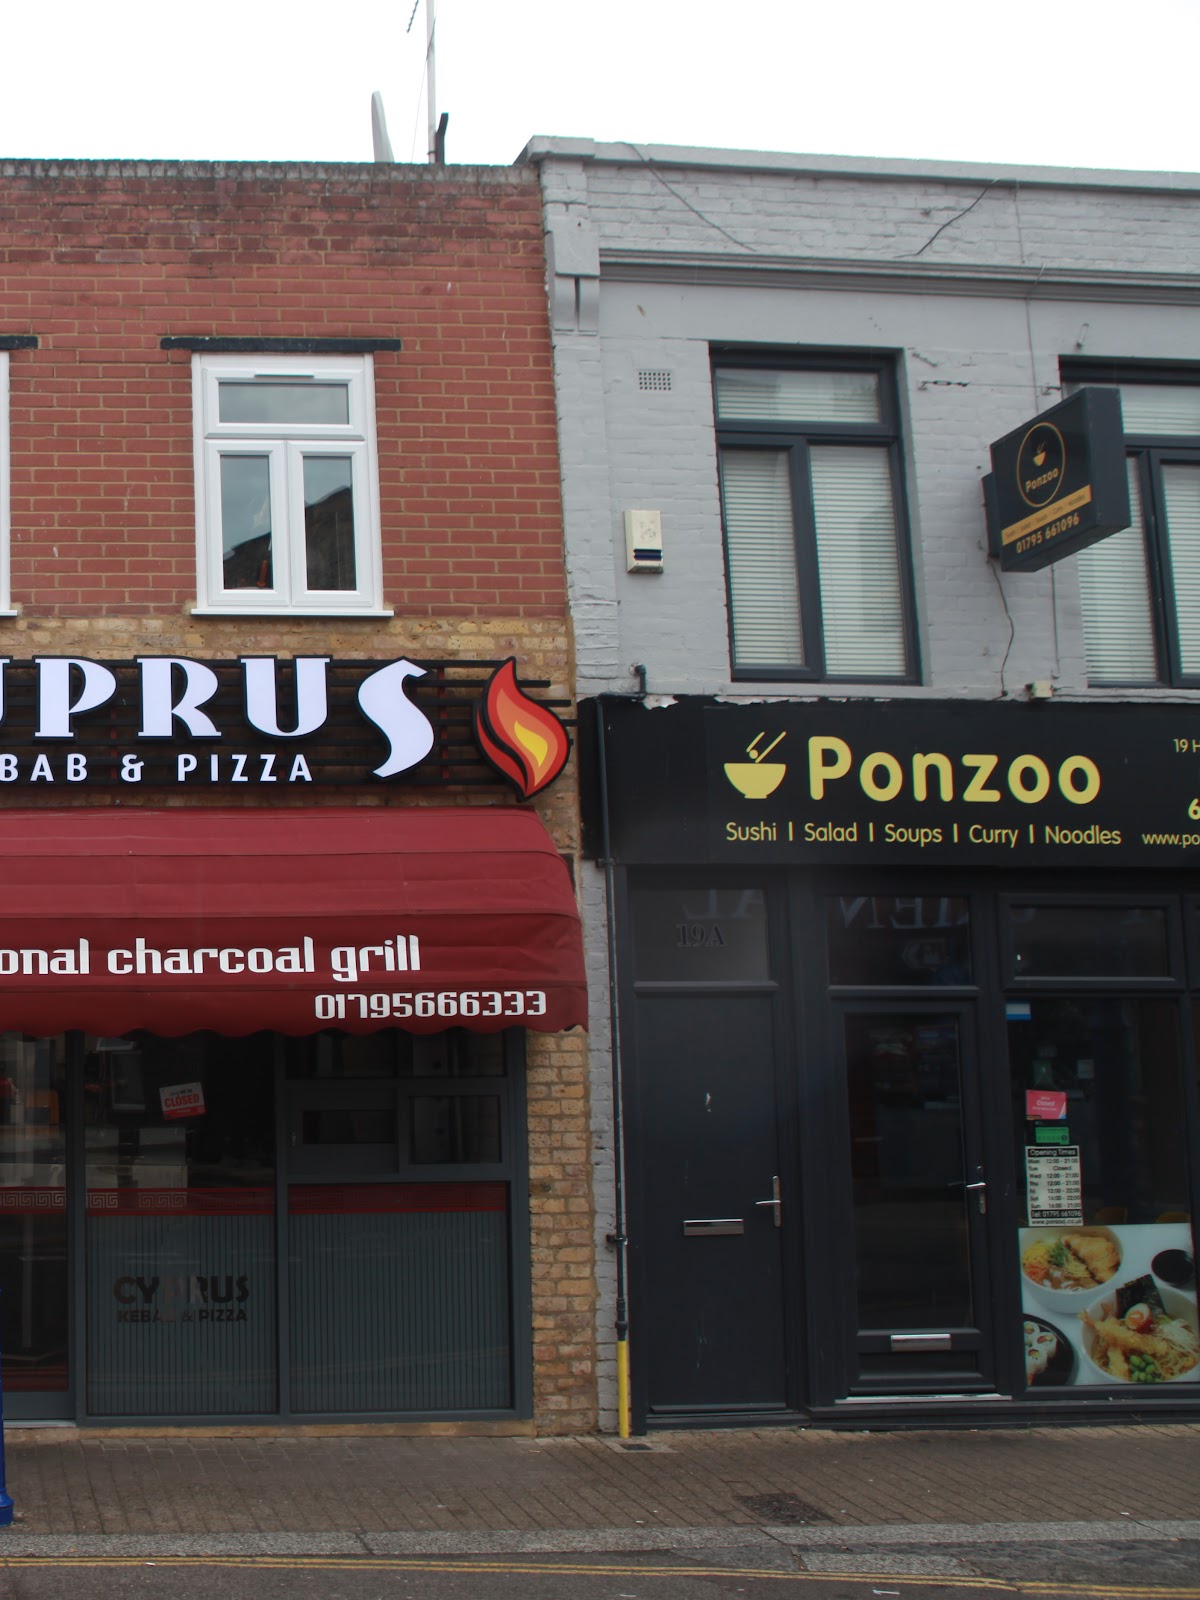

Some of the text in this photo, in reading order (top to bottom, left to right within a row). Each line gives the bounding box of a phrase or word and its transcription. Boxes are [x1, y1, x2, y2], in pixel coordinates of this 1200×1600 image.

[1025, 467, 1059, 493] Ponzoo
[1016, 531, 1043, 554] 01795
[1045, 512, 1080, 540] 661096
[1173, 738, 1189, 753] 19
[121, 754, 145, 782] &
[178, 753, 313, 782] PIZZA
[808, 735, 1102, 805] Ponzoo
[726, 820, 777, 842] Sushi
[804, 821, 858, 843] Salad
[884, 823, 943, 848] Soups
[969, 824, 1019, 849] Curry
[1045, 824, 1122, 846] Noodles
[675, 923, 728, 947] 19A
[107, 936, 315, 975] charcoal
[330, 934, 421, 982] grill
[314, 990, 547, 1019] 01795666333
[164, 1093, 200, 1109] CLOSED
[1030, 1148, 1076, 1157] Opening Times
[198, 1308, 248, 1323] PIZZA
